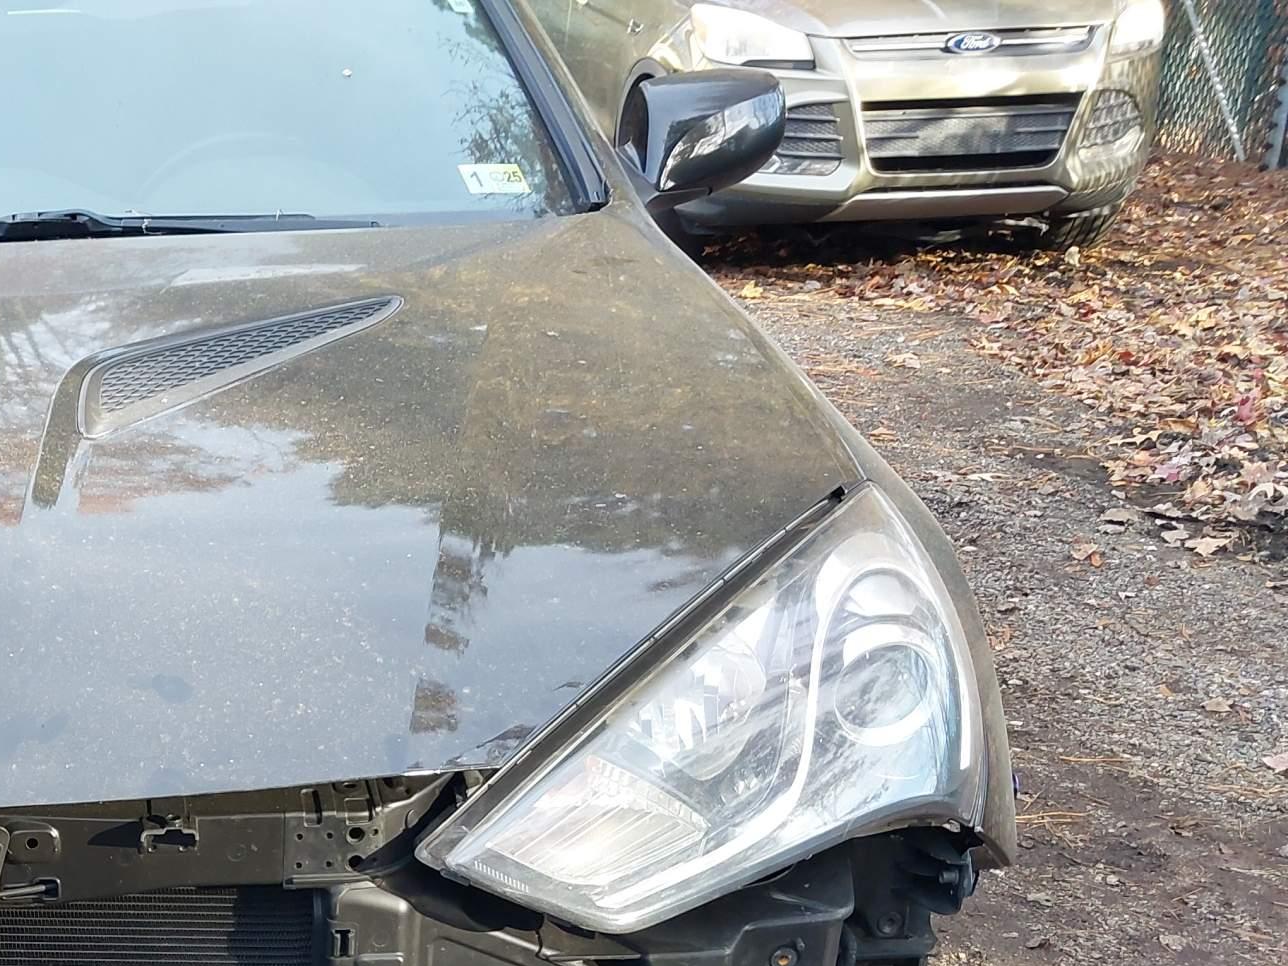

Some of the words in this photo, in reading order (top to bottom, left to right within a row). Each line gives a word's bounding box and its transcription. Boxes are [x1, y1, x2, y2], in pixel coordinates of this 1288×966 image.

[960, 34, 994, 50] Ford
[470, 171, 484, 187] 1
[504, 171, 523, 183] 25
